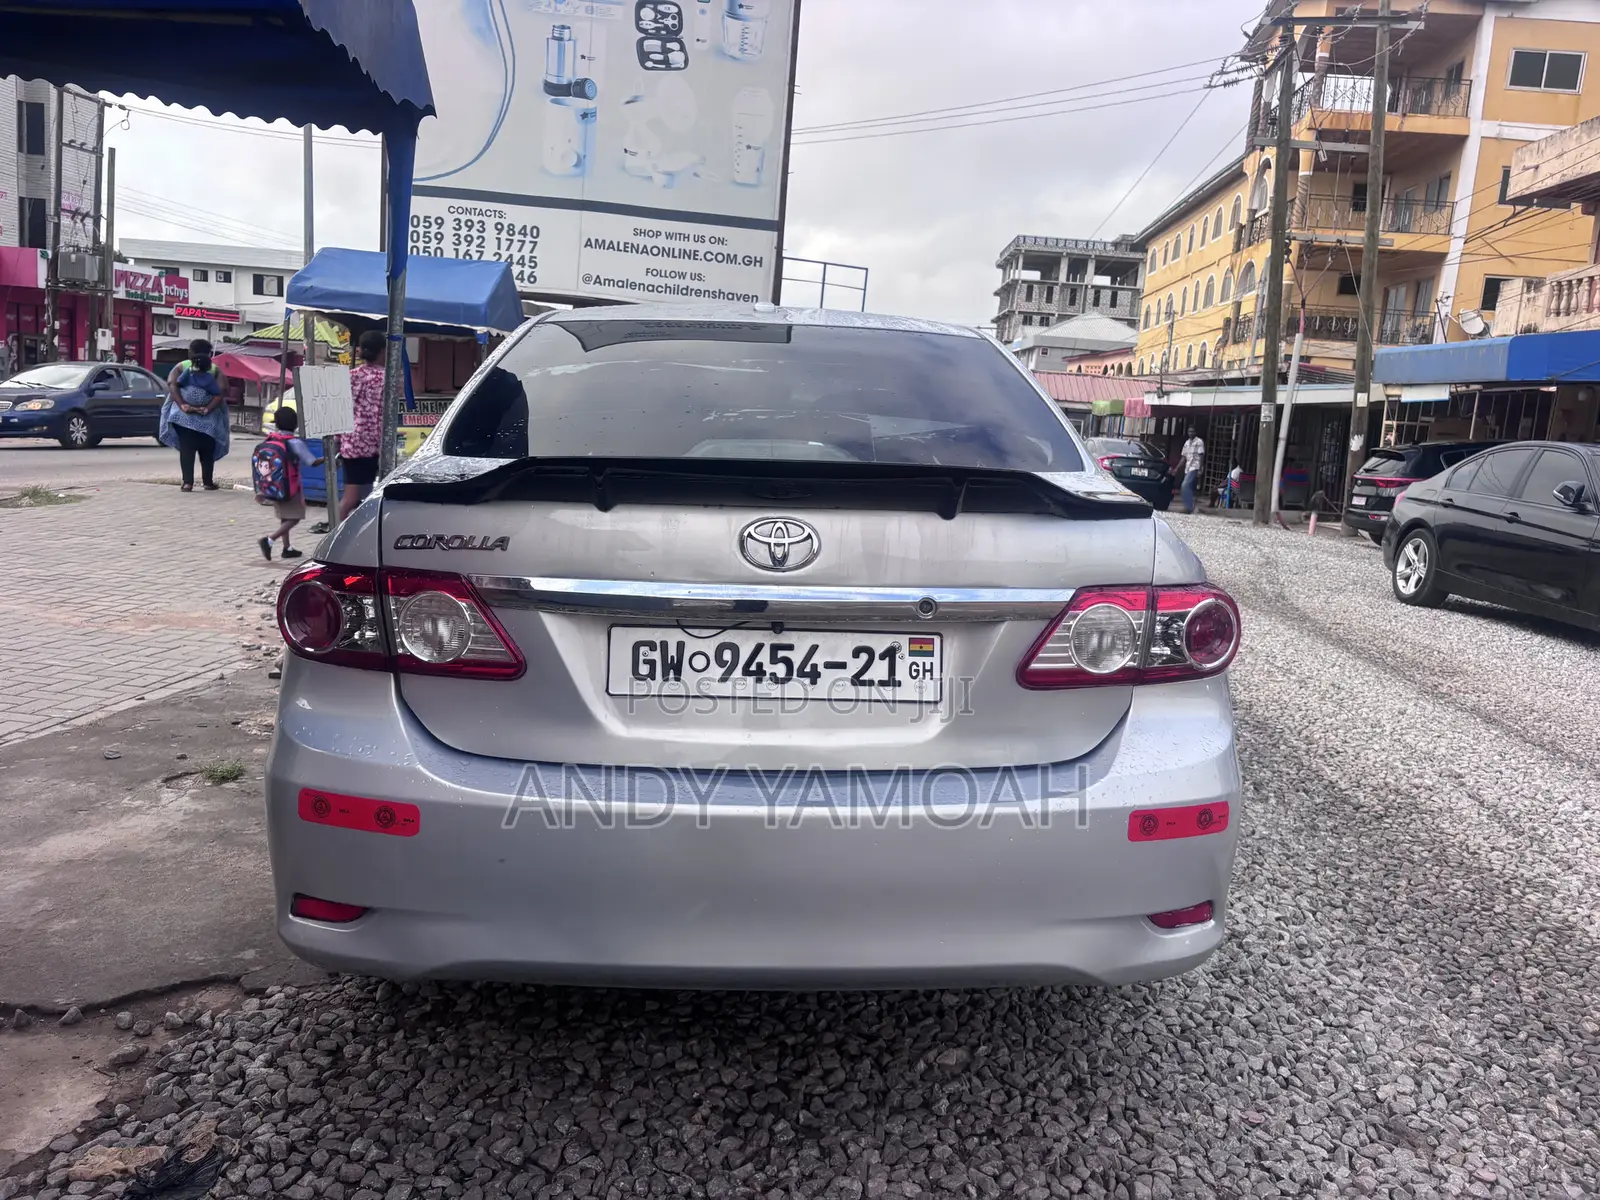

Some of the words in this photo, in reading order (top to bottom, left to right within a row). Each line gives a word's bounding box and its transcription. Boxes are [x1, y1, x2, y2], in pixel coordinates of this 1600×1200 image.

[447, 205, 507, 220] CONTACTS:
[410, 215, 445, 231] 059
[452, 218, 486, 234] 393
[494, 221, 540, 240] 9840
[632, 227, 662, 239] SHOP
[664, 231, 690, 242] WITH
[693, 233, 706, 244] US
[708, 235, 728, 246] ON:
[410, 230, 445, 246] 059
[452, 233, 486, 249] 392
[495, 237, 538, 254] 1777
[583, 237, 763, 268] AMALENAONLINE.COM.GH
[454, 248, 484, 261] 167
[493, 251, 538, 270] 2445
[114, 269, 163, 294] PIZZA
[514, 270, 538, 285] 46
[645, 267, 687, 280] FOLLOW
[690, 272, 706, 282] US:
[581, 273, 760, 304] @Amalenachildrenshaven
[403, 414, 441, 426] EMBOSS
[393, 534, 510, 551] COROLLA
[631, 639, 686, 682] GW
[714, 641, 902, 688] 9454-21
[908, 660, 935, 680] GH
